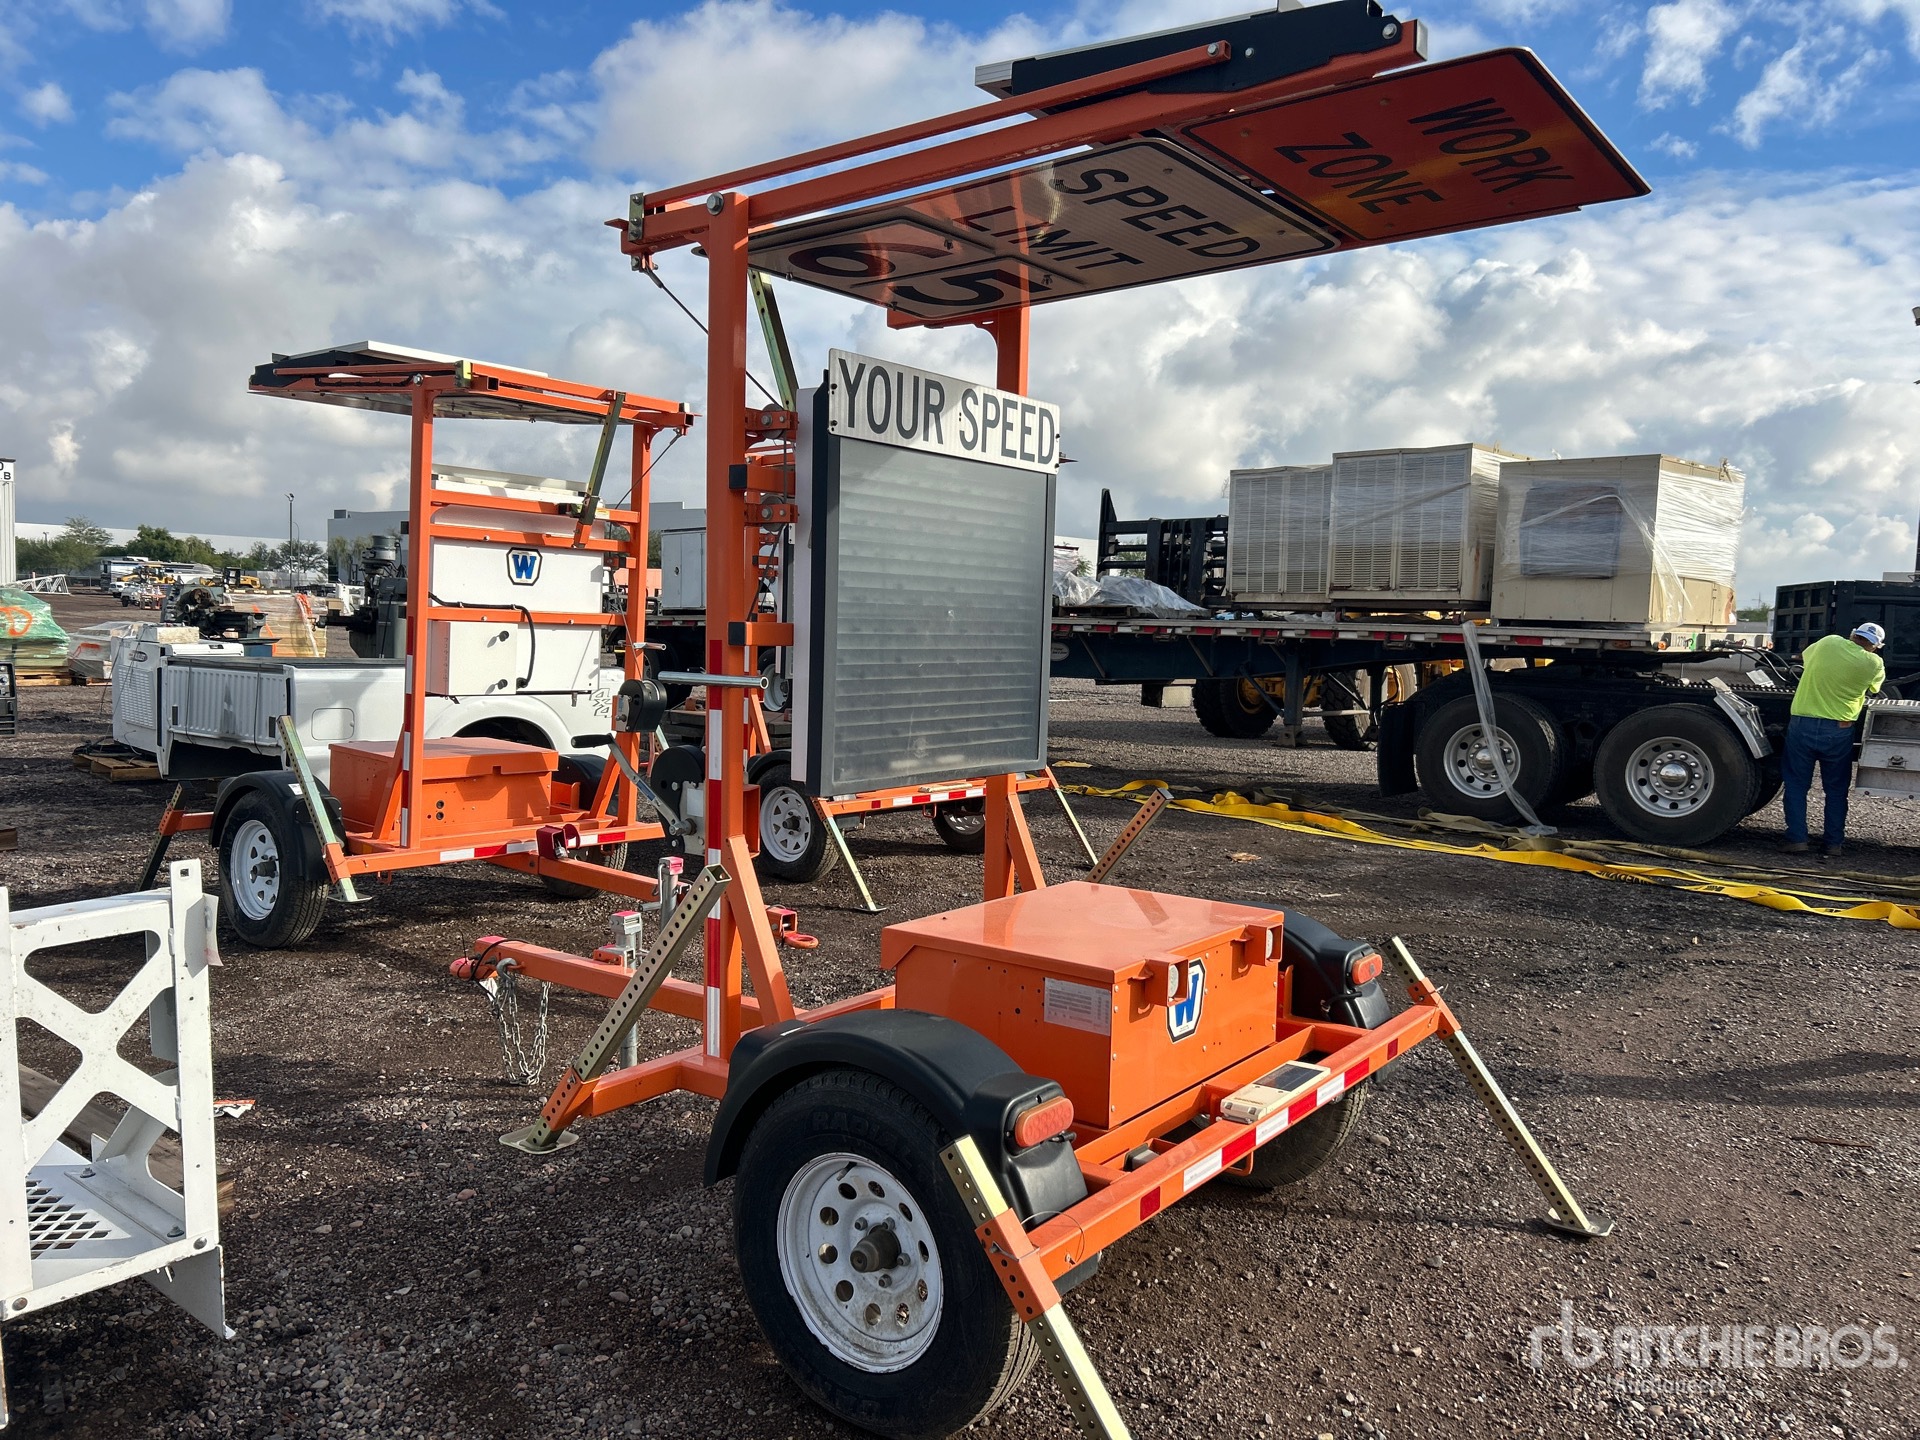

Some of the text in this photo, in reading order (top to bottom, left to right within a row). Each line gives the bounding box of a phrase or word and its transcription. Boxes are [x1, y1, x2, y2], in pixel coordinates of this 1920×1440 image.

[1273, 131, 1446, 214] ZONE
[1407, 97, 1575, 195] WORK
[952, 205, 1143, 272] LIMIT
[1062, 168, 1261, 259] SPEED
[788, 243, 1052, 306] 65
[838, 357, 1056, 465] YOUR SPEED
[512, 554, 537, 579] W
